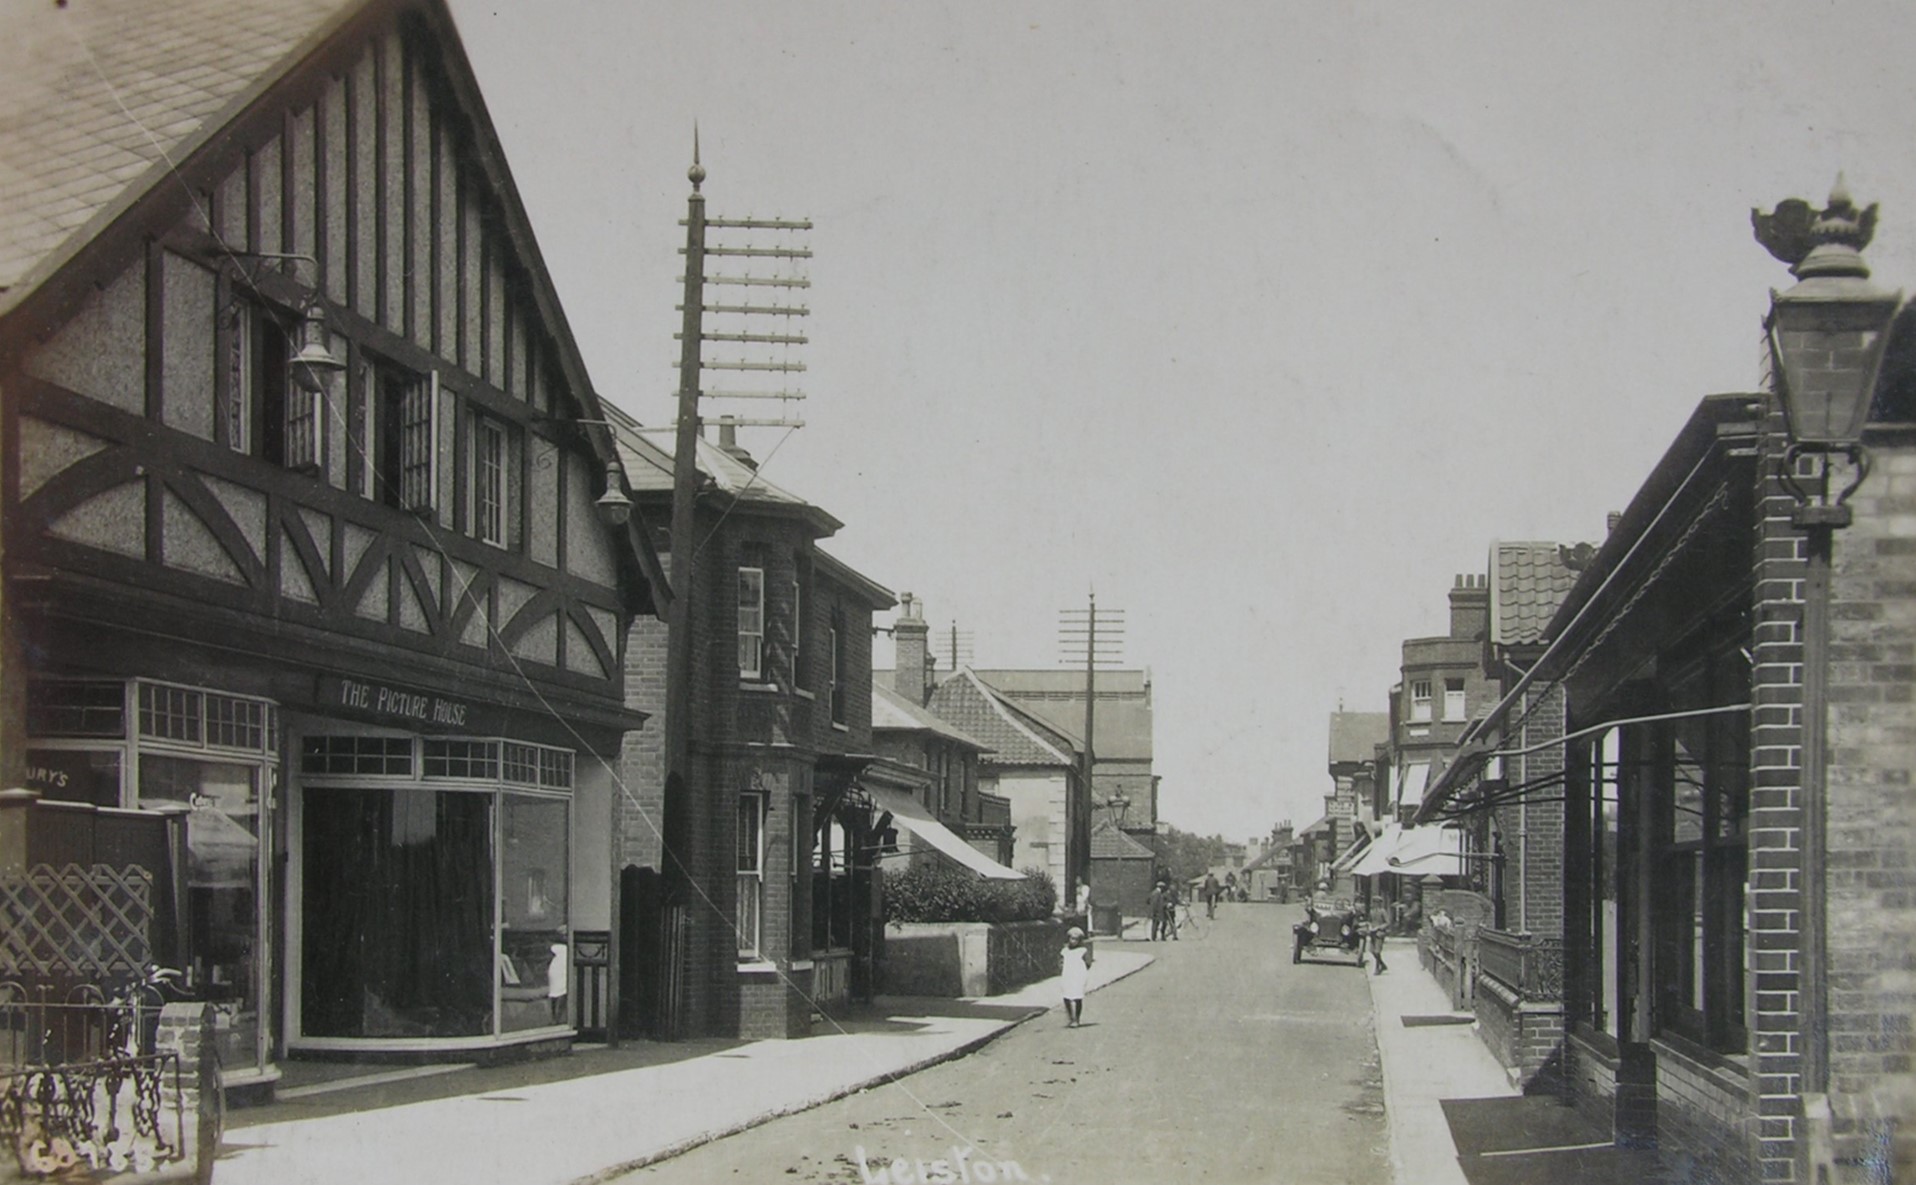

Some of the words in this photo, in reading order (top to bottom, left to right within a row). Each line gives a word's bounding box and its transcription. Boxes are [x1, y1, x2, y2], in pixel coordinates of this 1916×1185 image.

[341, 679, 370, 709] THE
[377, 686, 428, 719] PICTURE
[433, 697, 467, 726] HOUSE
